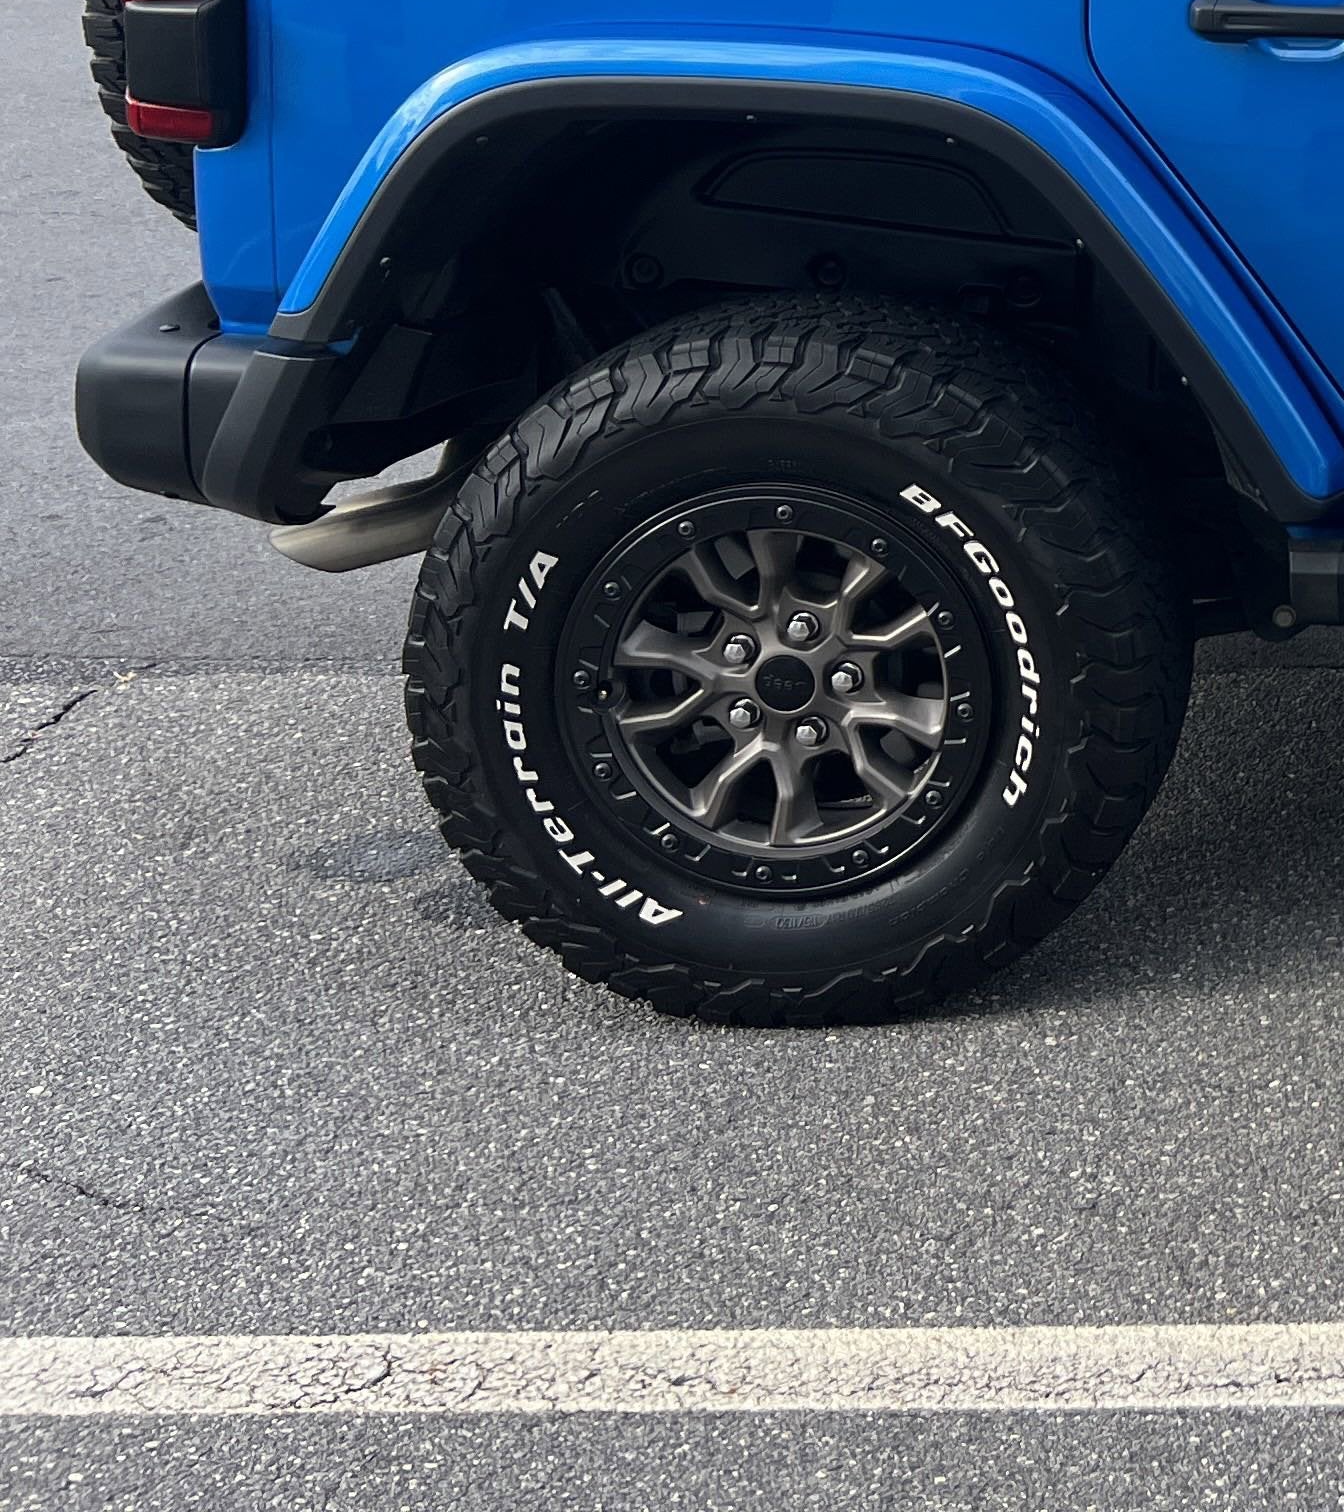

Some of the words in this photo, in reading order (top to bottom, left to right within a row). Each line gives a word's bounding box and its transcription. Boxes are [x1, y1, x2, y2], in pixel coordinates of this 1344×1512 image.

[503, 551, 559, 631] T/A
[899, 484, 1041, 807] BFGoodrich
[499, 663, 684, 925] All-Terrain
